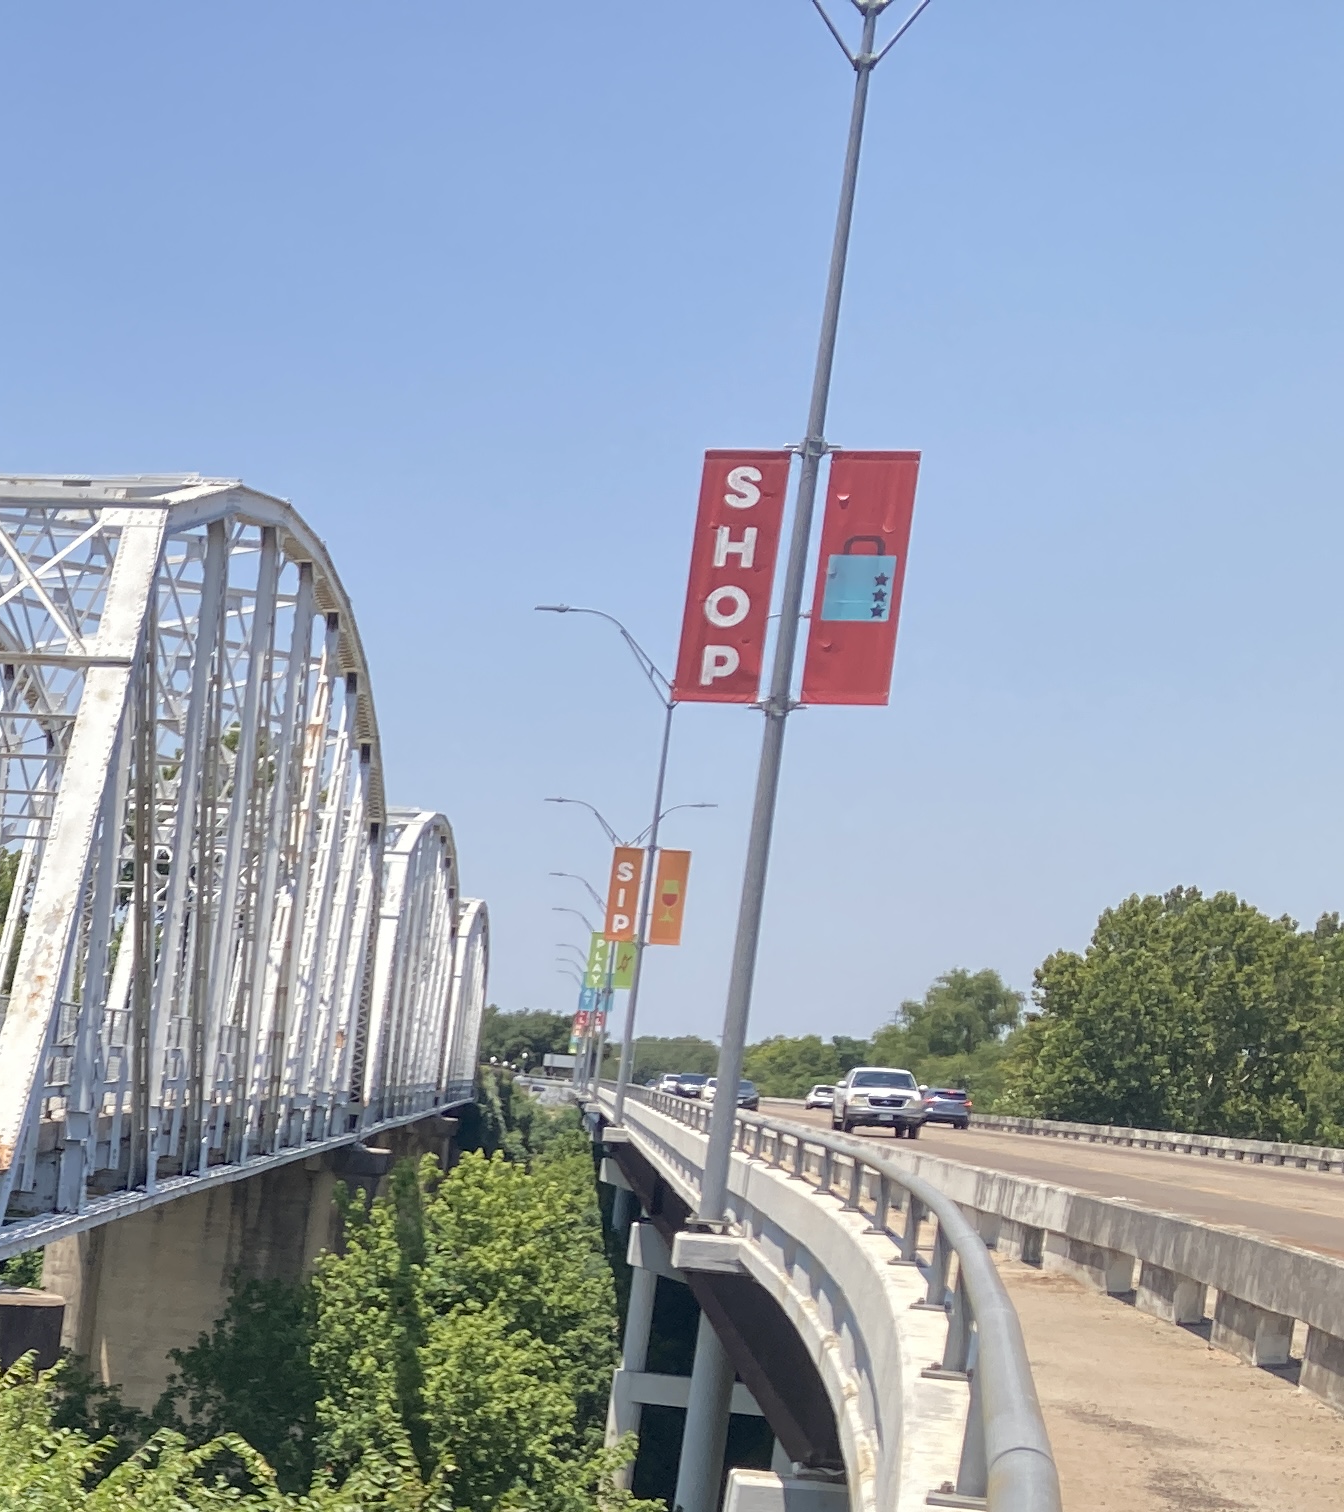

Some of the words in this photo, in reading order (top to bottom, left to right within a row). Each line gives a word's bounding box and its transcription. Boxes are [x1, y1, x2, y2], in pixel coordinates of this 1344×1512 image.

[698, 465, 763, 687] SHOP
[613, 861, 634, 933] SIP
[592, 939, 605, 984] PLAY
